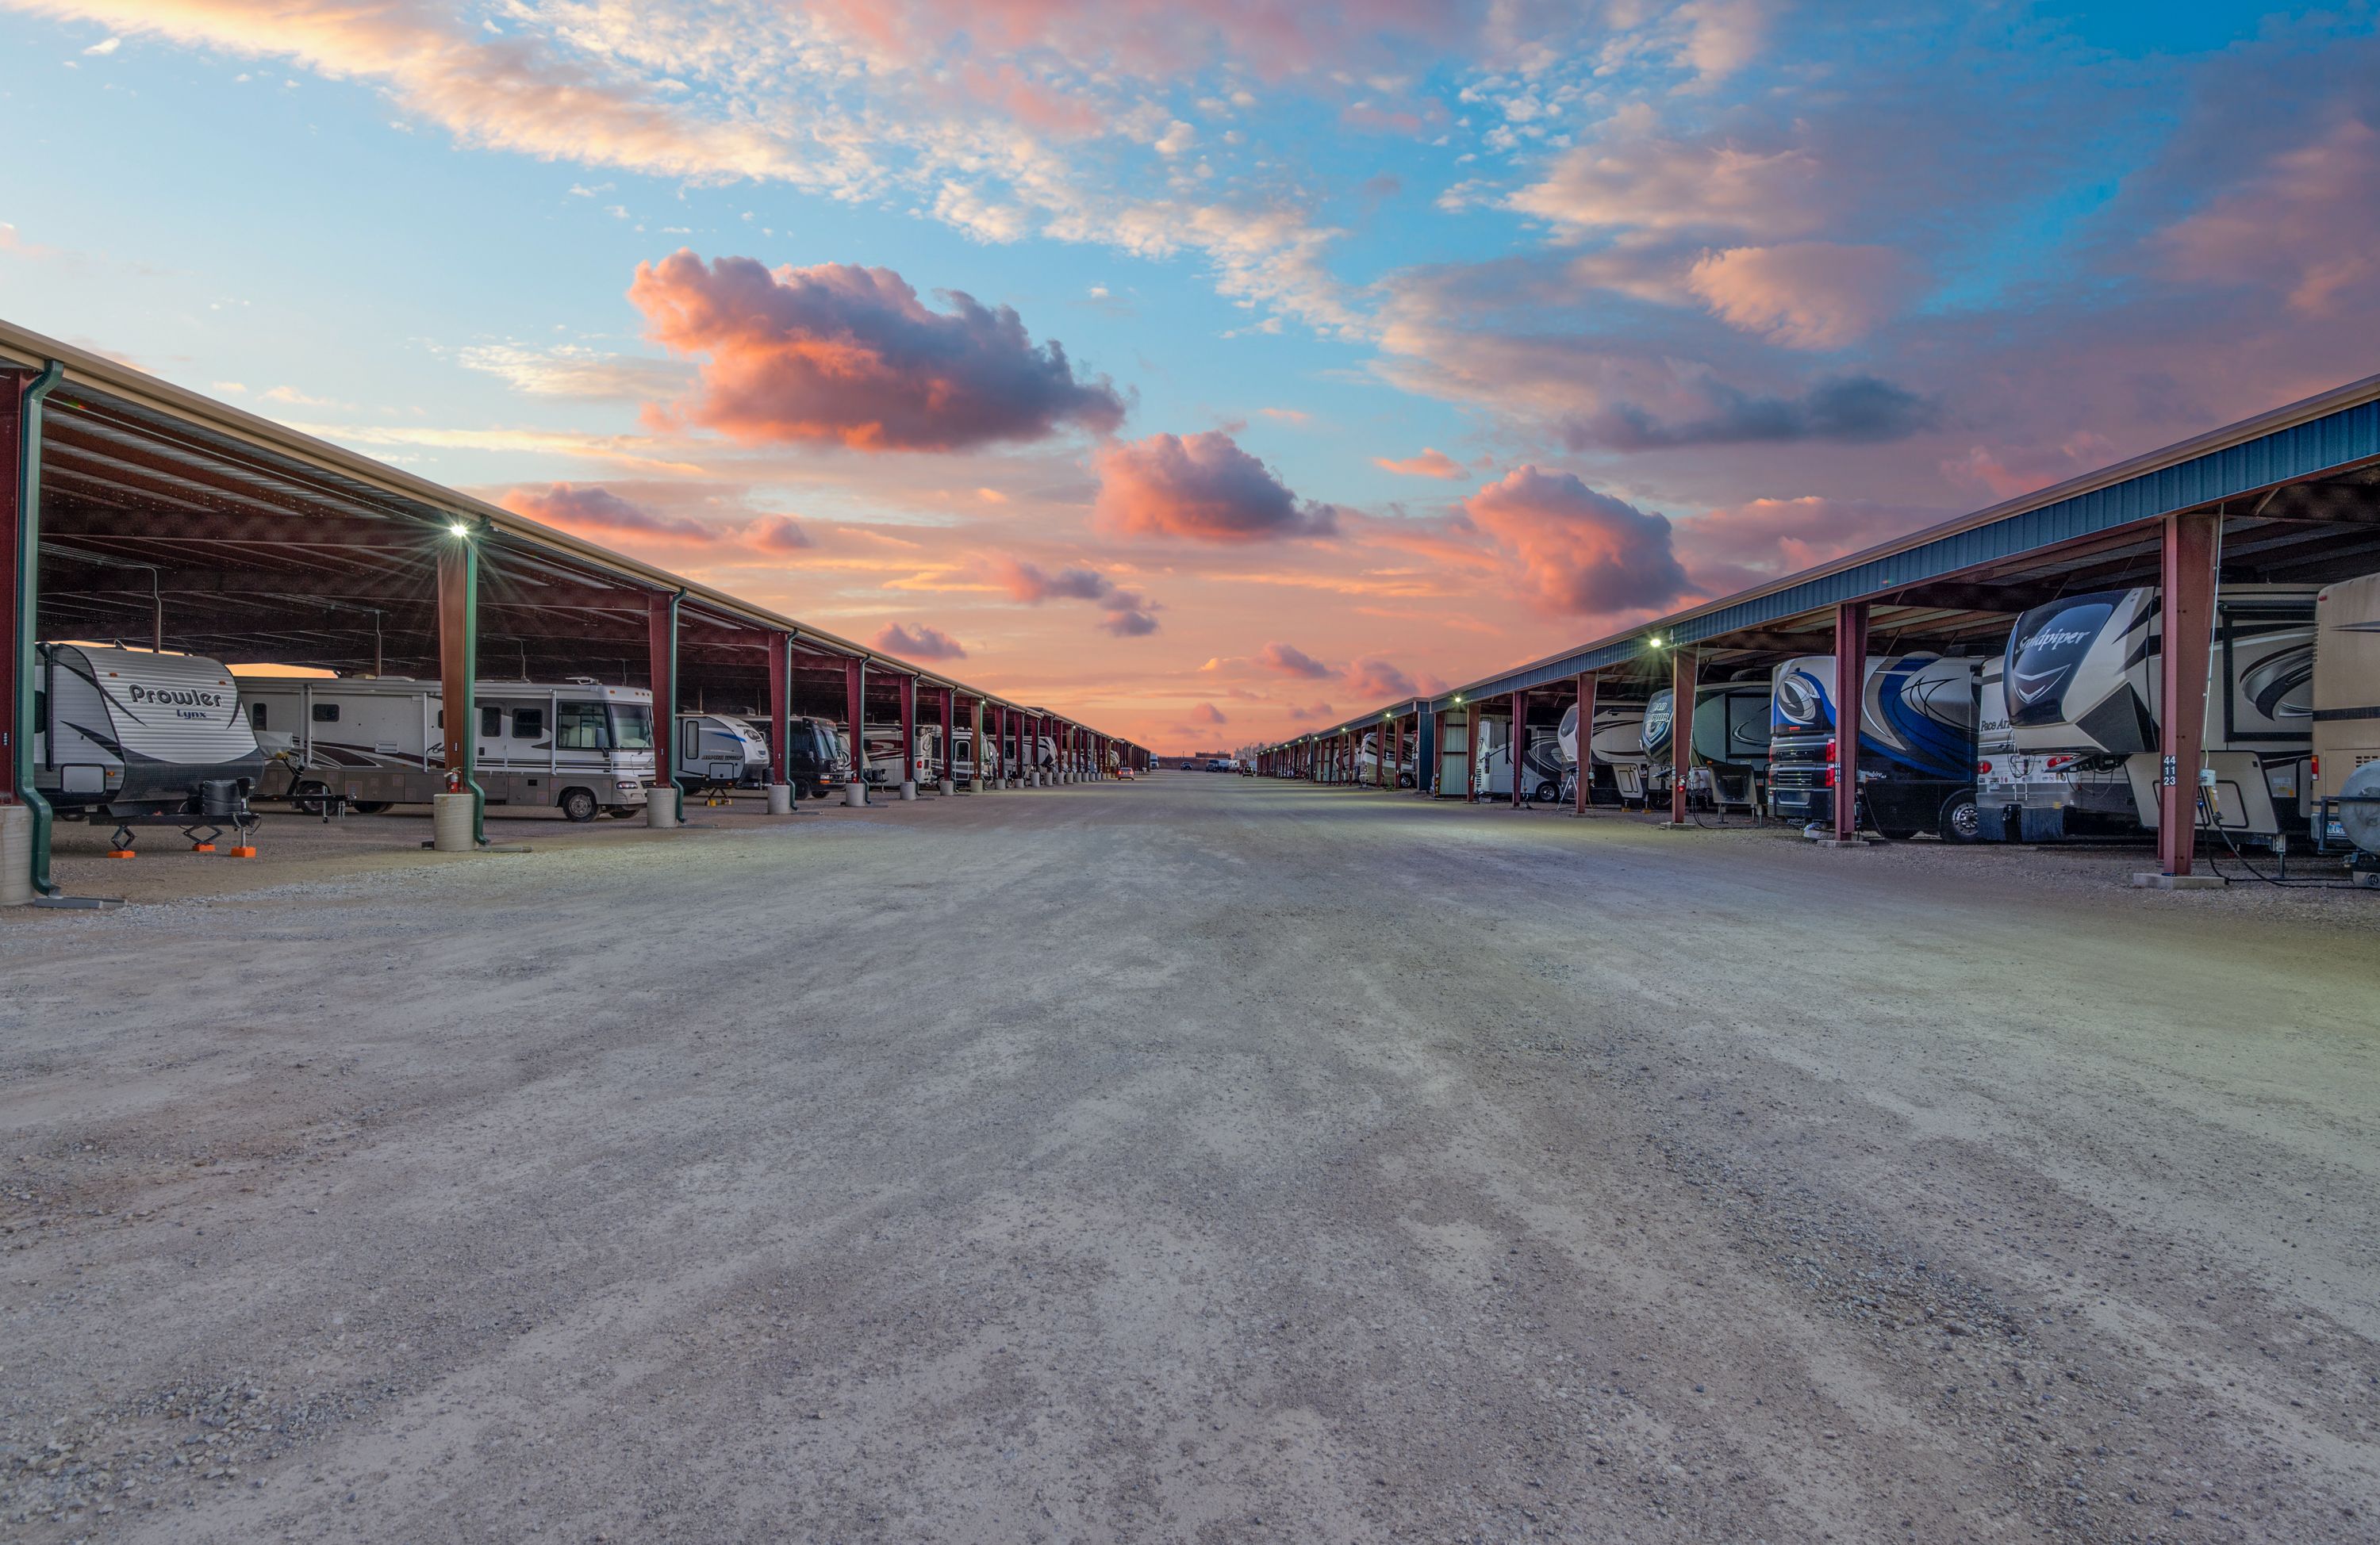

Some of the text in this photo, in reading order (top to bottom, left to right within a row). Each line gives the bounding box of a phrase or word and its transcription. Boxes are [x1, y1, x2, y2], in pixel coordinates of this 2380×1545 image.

[2015, 628, 2090, 654] Sandpiper
[129, 684, 222, 707] Prowler
[177, 709, 206, 719] Lynx
[1980, 720, 1996, 731] Pace
[2164, 756, 2175, 765] 44
[2165, 766, 2175, 775] 11
[2164, 776, 2175, 785] 23
